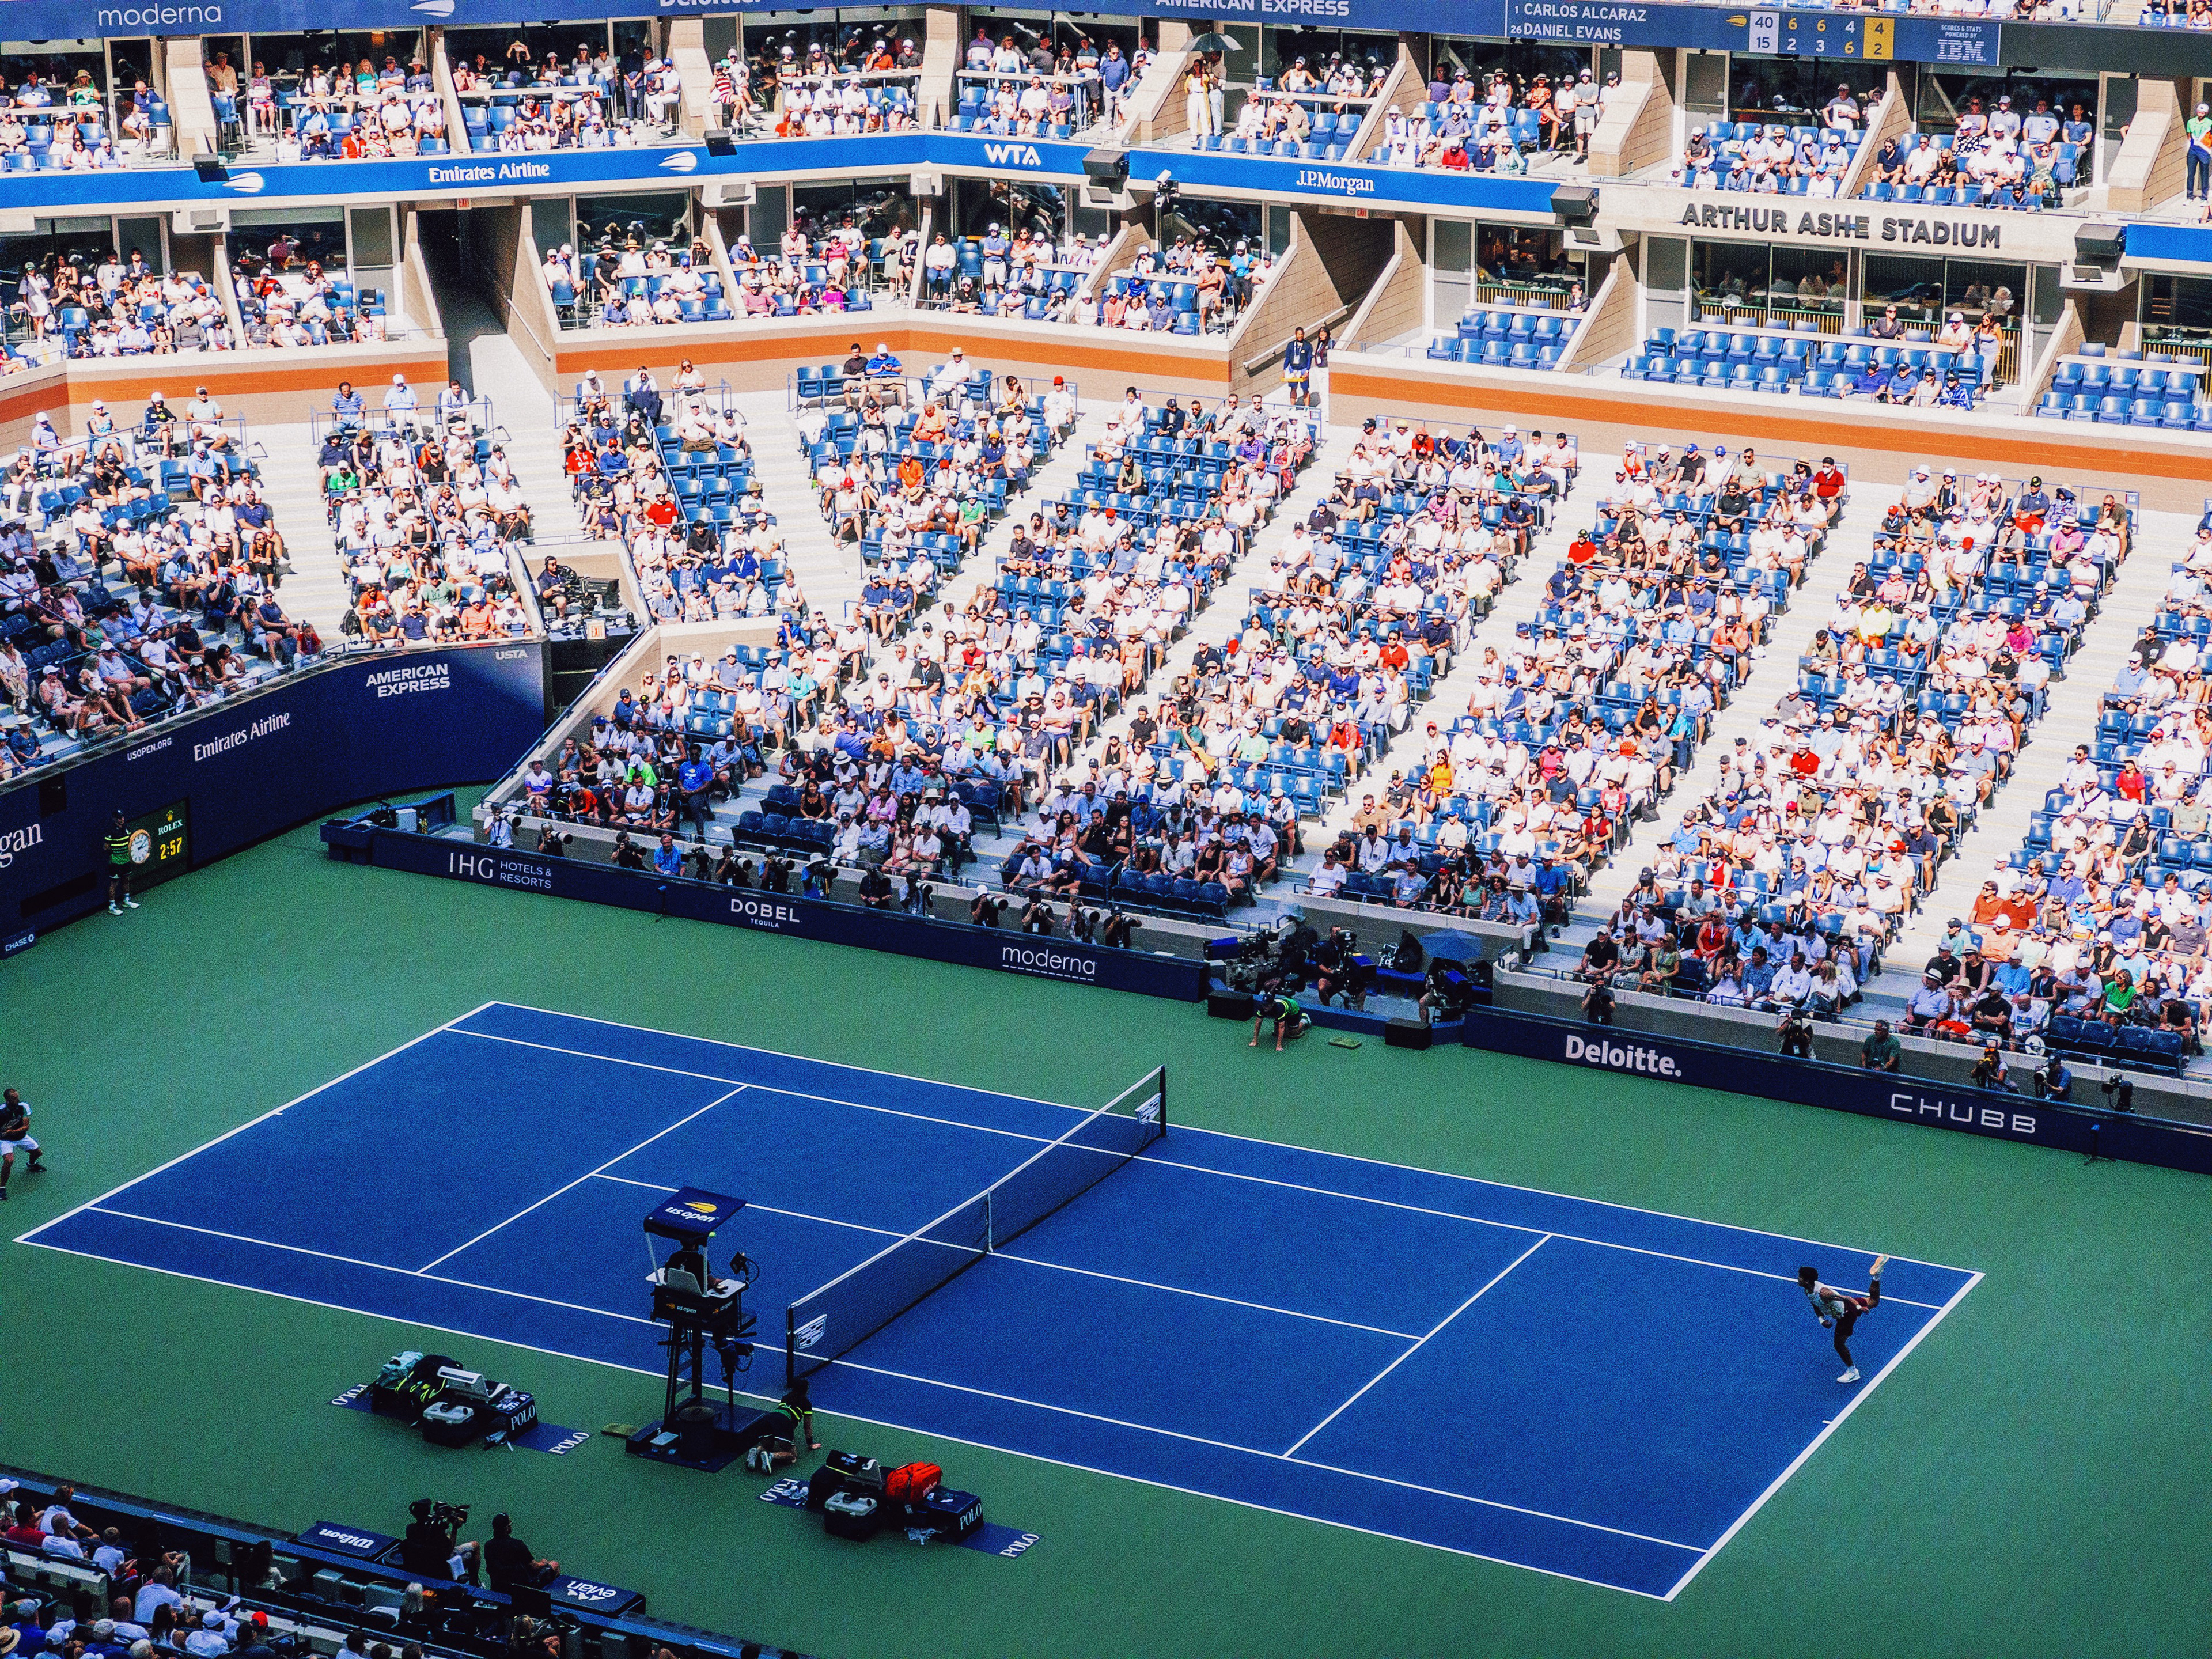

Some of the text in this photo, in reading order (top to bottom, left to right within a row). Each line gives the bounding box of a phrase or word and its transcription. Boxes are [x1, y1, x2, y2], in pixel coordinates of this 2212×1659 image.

[98, 3, 221, 26] moderna
[1262, 0, 1350, 16] EXPRESS
[1515, 3, 1647, 22] 1 CARLOS ALCARAZ
[1510, 23, 1622, 40] 26 DANIEL EVANS
[1755, 17, 1884, 34] 40 6 6 4 4
[1756, 37, 1882, 55] 15 2 3 6 2
[1937, 39, 1984, 61] IBM
[984, 143, 1041, 165] WTA
[429, 162, 549, 183] Emirates Airline
[1296, 170, 1374, 195] J.P.Morgan
[1682, 203, 2001, 249] ARTHUR ASHE STADIUM
[592, 626, 602, 637] EXIT
[495, 649, 528, 660] USTA
[366, 664, 448, 687] AMERICAN
[377, 677, 450, 698] EXPRESS
[194, 713, 290, 762] Emirates Airline
[127, 737, 172, 761] USOPEN.ORG
[158, 819, 183, 835] ROLEX
[160, 837, 182, 860] 2:57
[449, 853, 493, 878] IHG
[501, 861, 552, 877] HOTELS &
[500, 873, 551, 888] RESORTS
[731, 899, 800, 922] DOBEL
[751, 918, 779, 928] TEQUILA
[5, 937, 28, 952] CHASE
[1002, 947, 1095, 975] moderna
[1566, 1035, 1681, 1077] Deloitte.
[1891, 1094, 2036, 1134] CHUBB
[681, 1212, 715, 1222] open
[511, 1404, 536, 1430] POLO
[548, 1433, 589, 1455] POLO
[960, 1503, 982, 1531] POLO
[319, 1528, 374, 1548] Wilson
[999, 1533, 1039, 1558] POLO
[567, 1581, 617, 1598] evian
